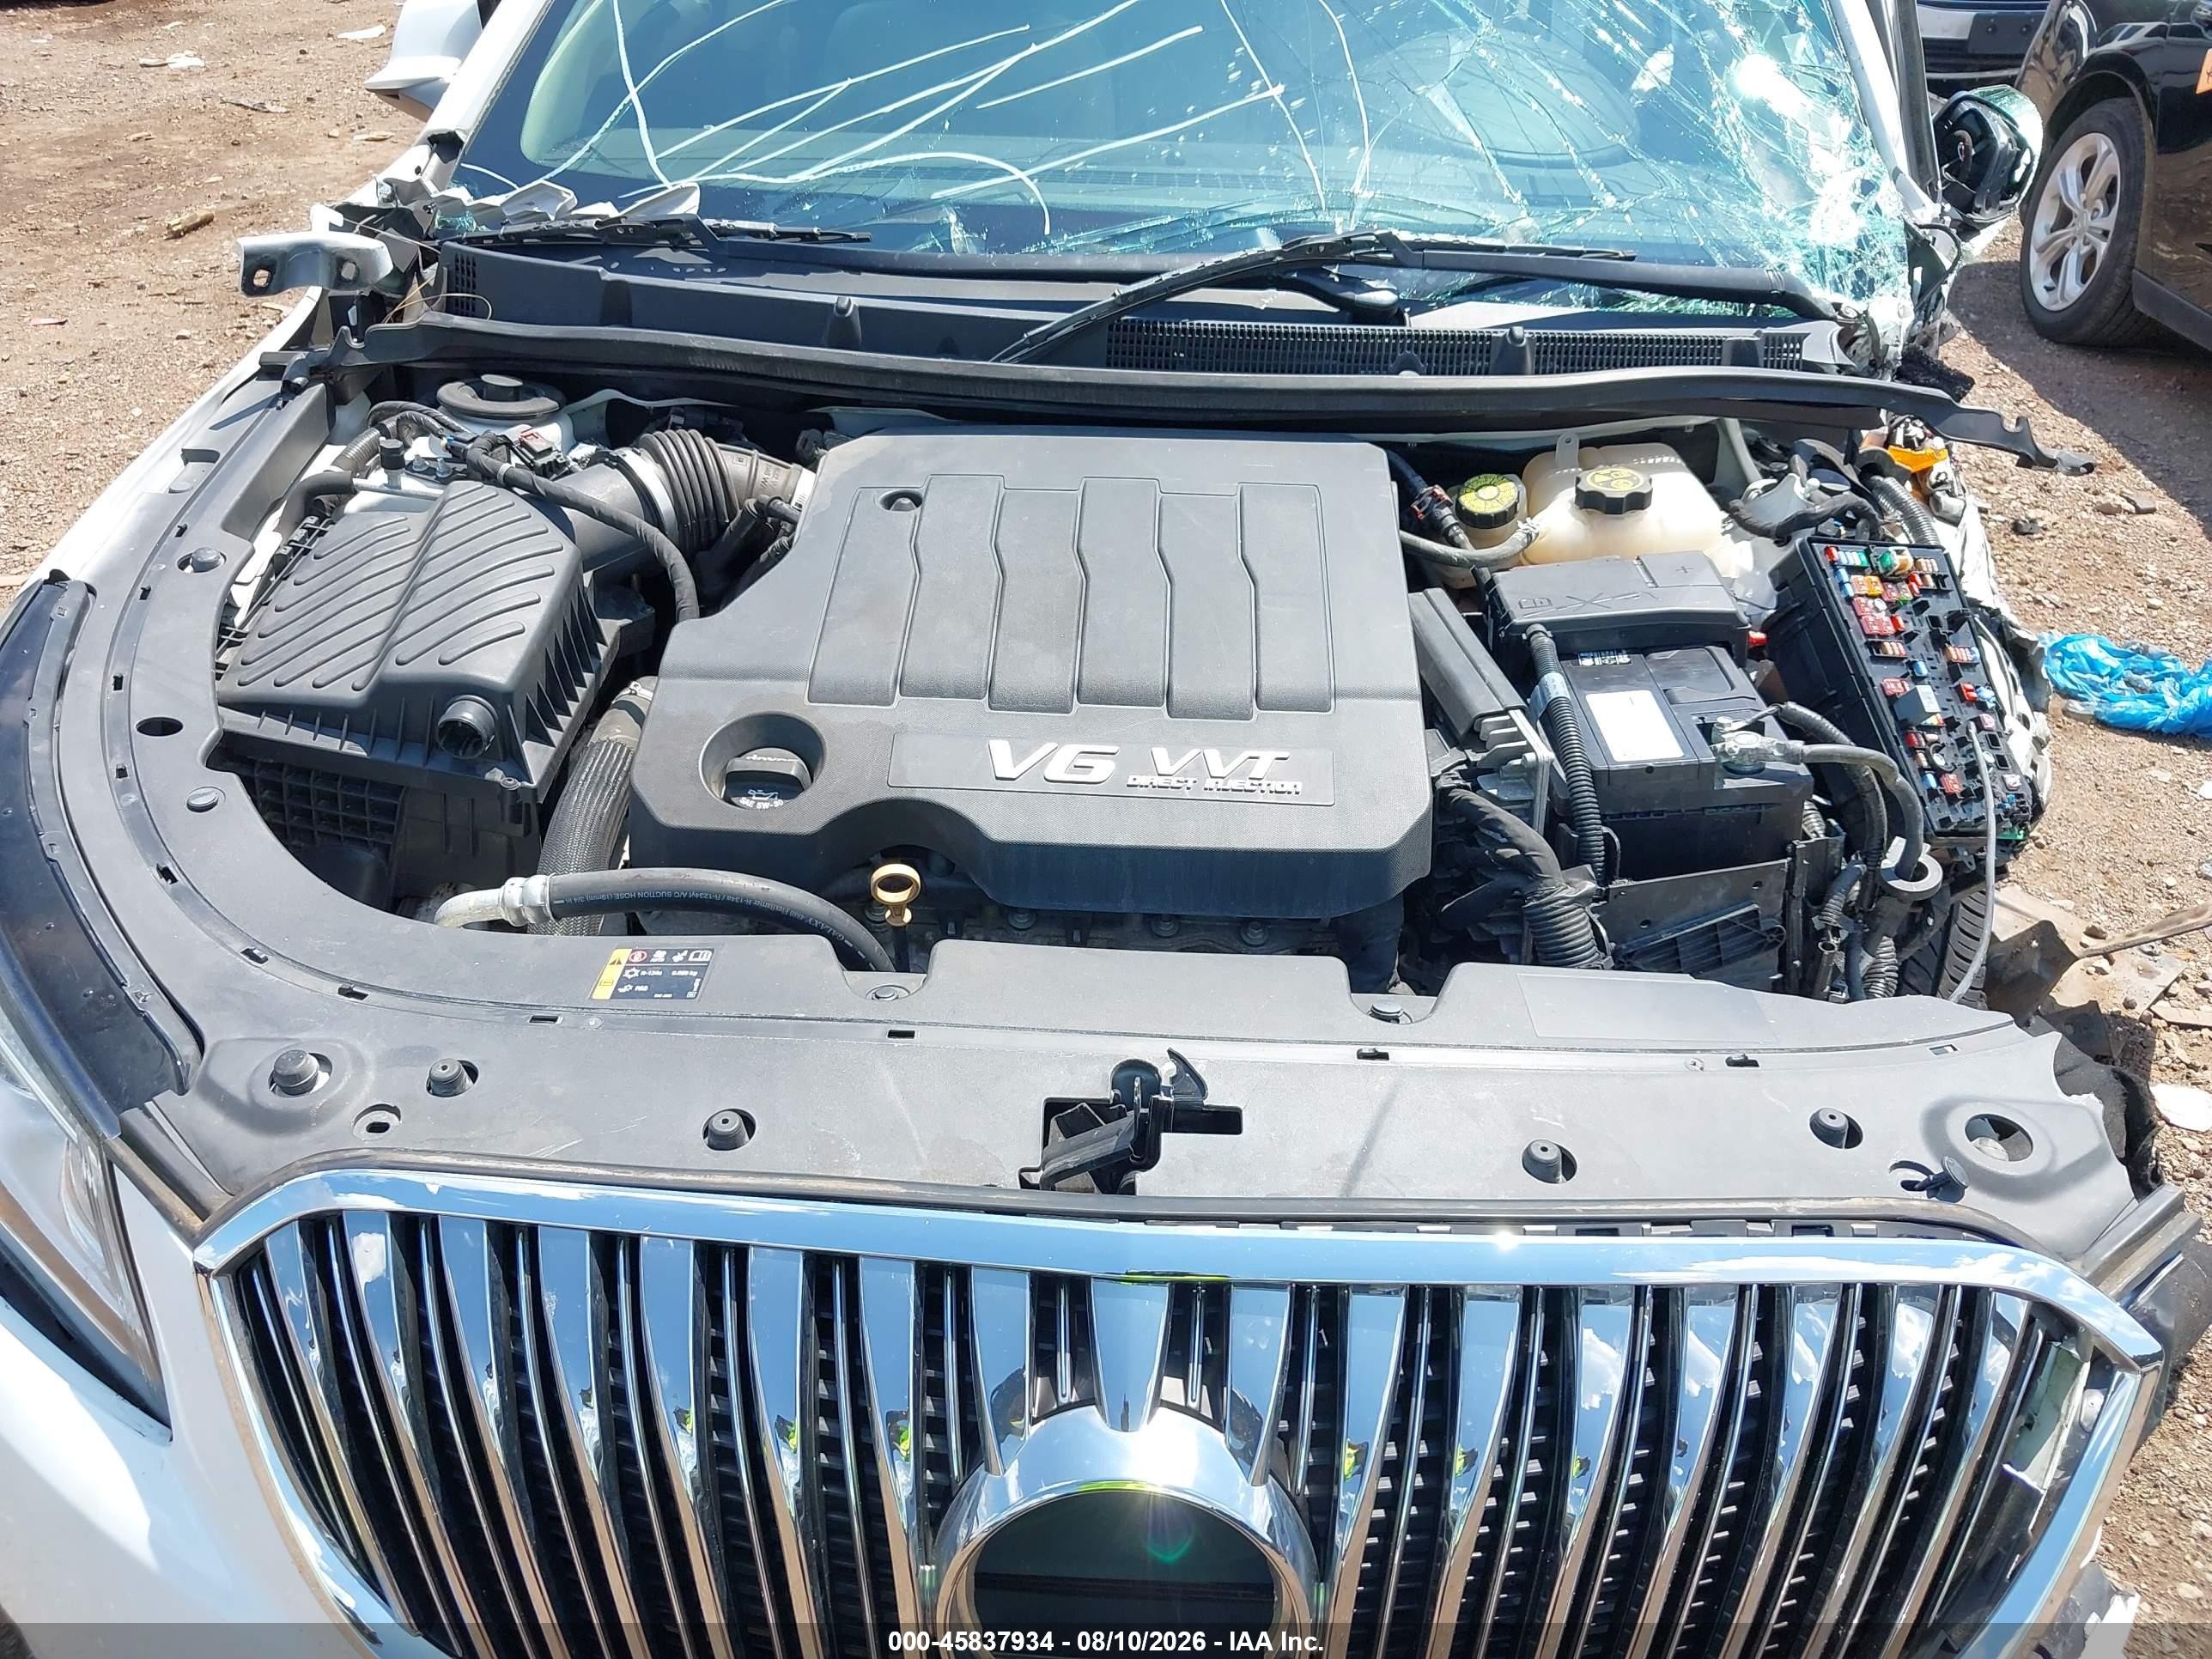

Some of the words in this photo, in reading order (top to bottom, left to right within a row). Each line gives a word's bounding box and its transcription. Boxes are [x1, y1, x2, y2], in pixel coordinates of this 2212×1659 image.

[988, 738, 1121, 785] V6
[1150, 746, 1291, 781] VVT
[1125, 773, 1199, 791] DIRECT
[1203, 775, 1304, 795] INJECTION
[738, 797, 756, 808] SAE
[756, 799, 784, 809] 5W-30
